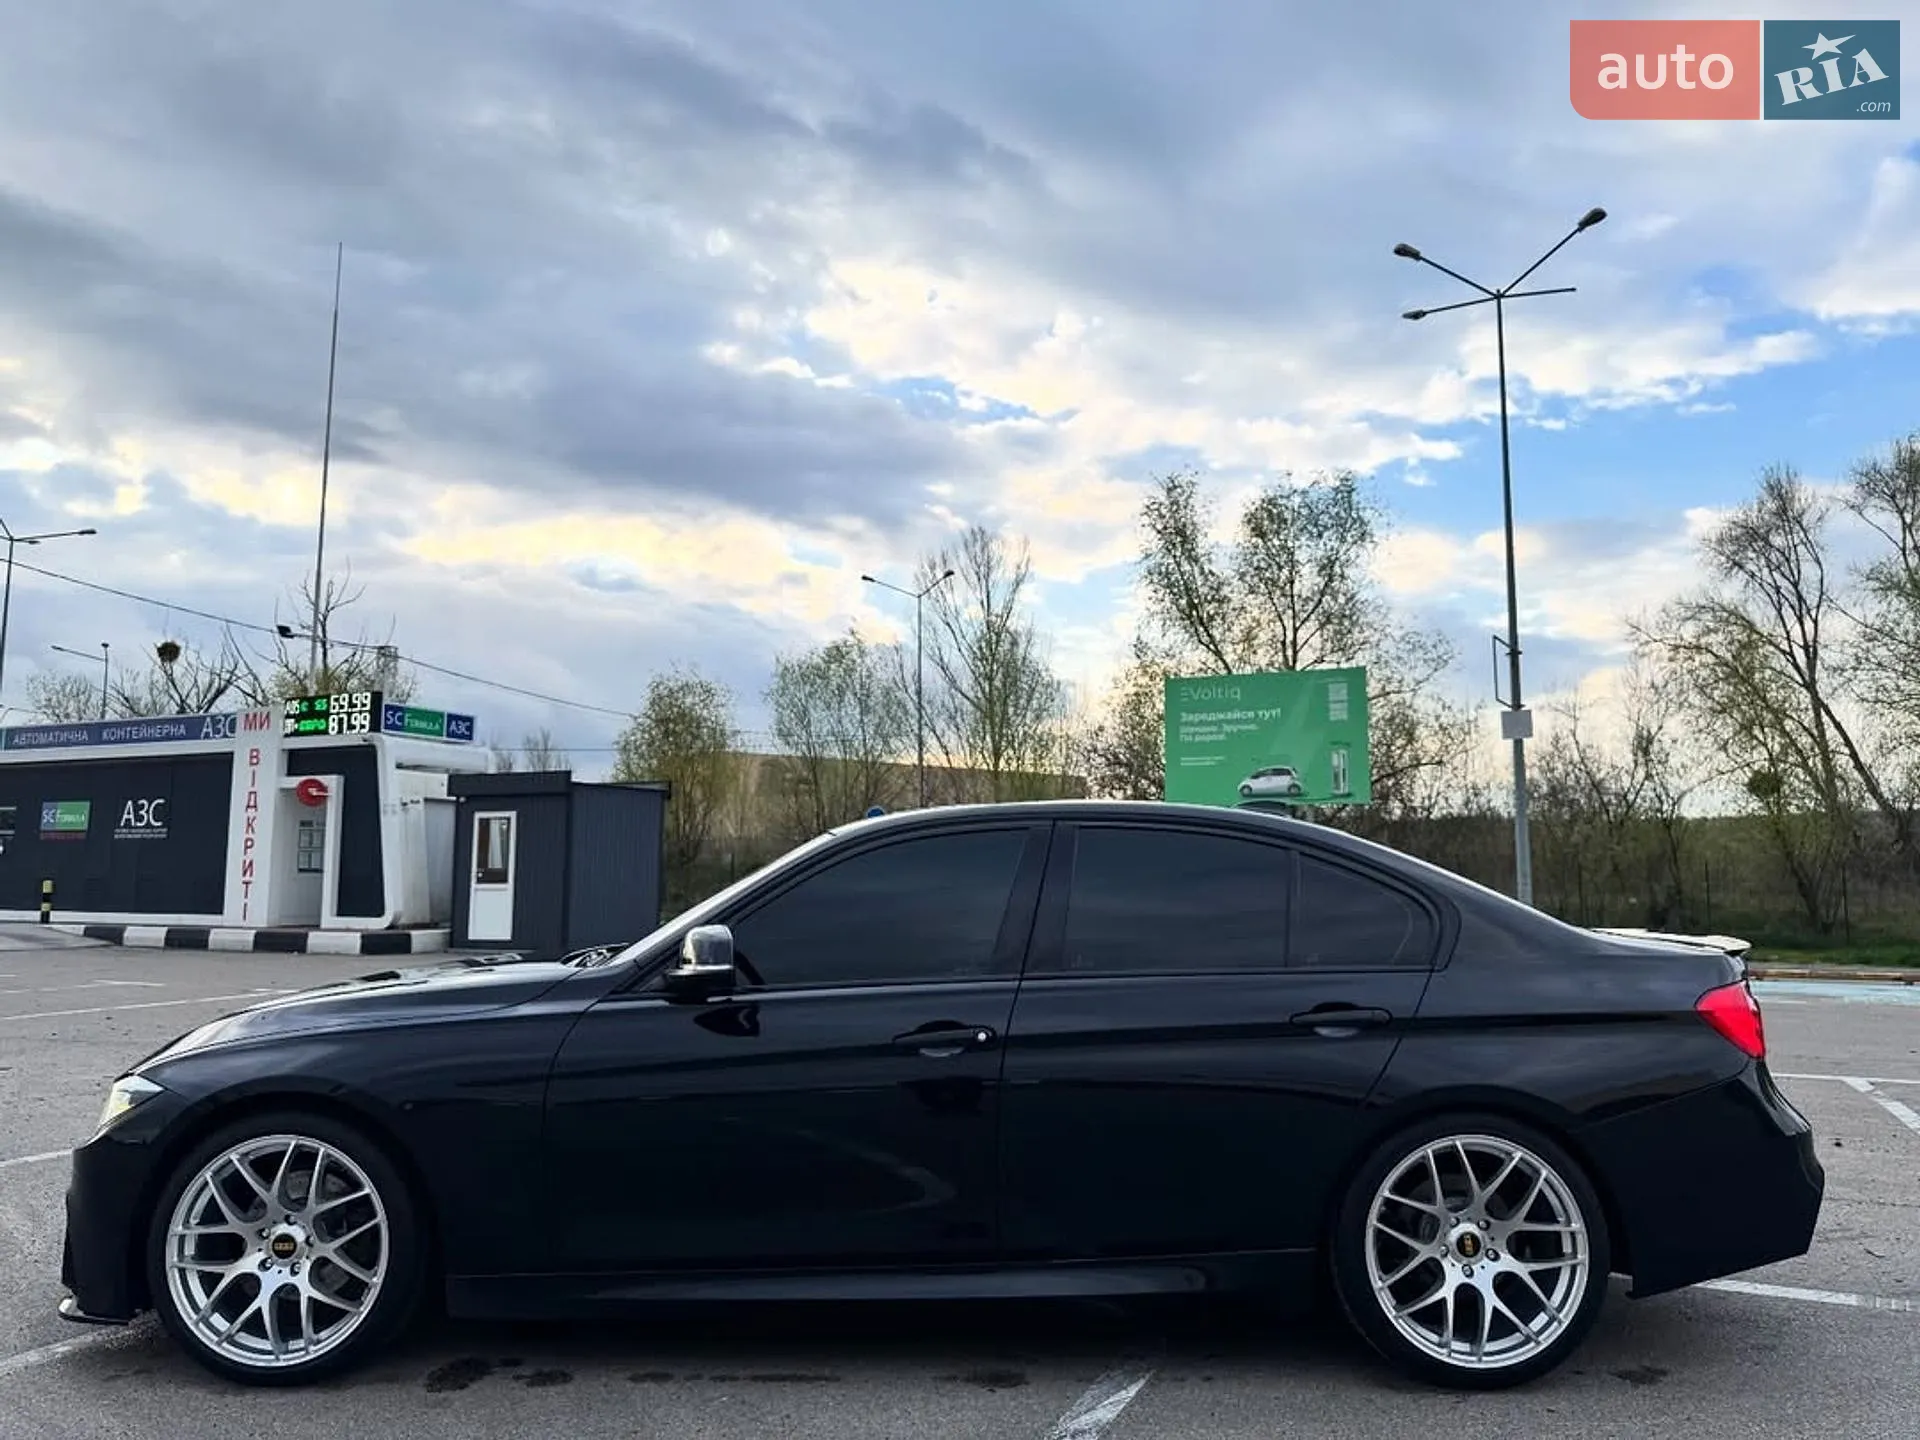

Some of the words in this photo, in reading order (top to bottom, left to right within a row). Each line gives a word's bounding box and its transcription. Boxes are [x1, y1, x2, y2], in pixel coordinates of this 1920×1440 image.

[329, 692, 371, 713] 69.99
[243, 711, 271, 731] МИ
[328, 712, 371, 735] 87.99
[449, 720, 471, 735] АЗС
[12, 730, 90, 746] АВТОМАТИЧНА
[102, 724, 187, 741] КОНТЕЙНЕРНА
[120, 799, 165, 827] АЗС
[242, 749, 261, 921] ВІДКРИТІ
